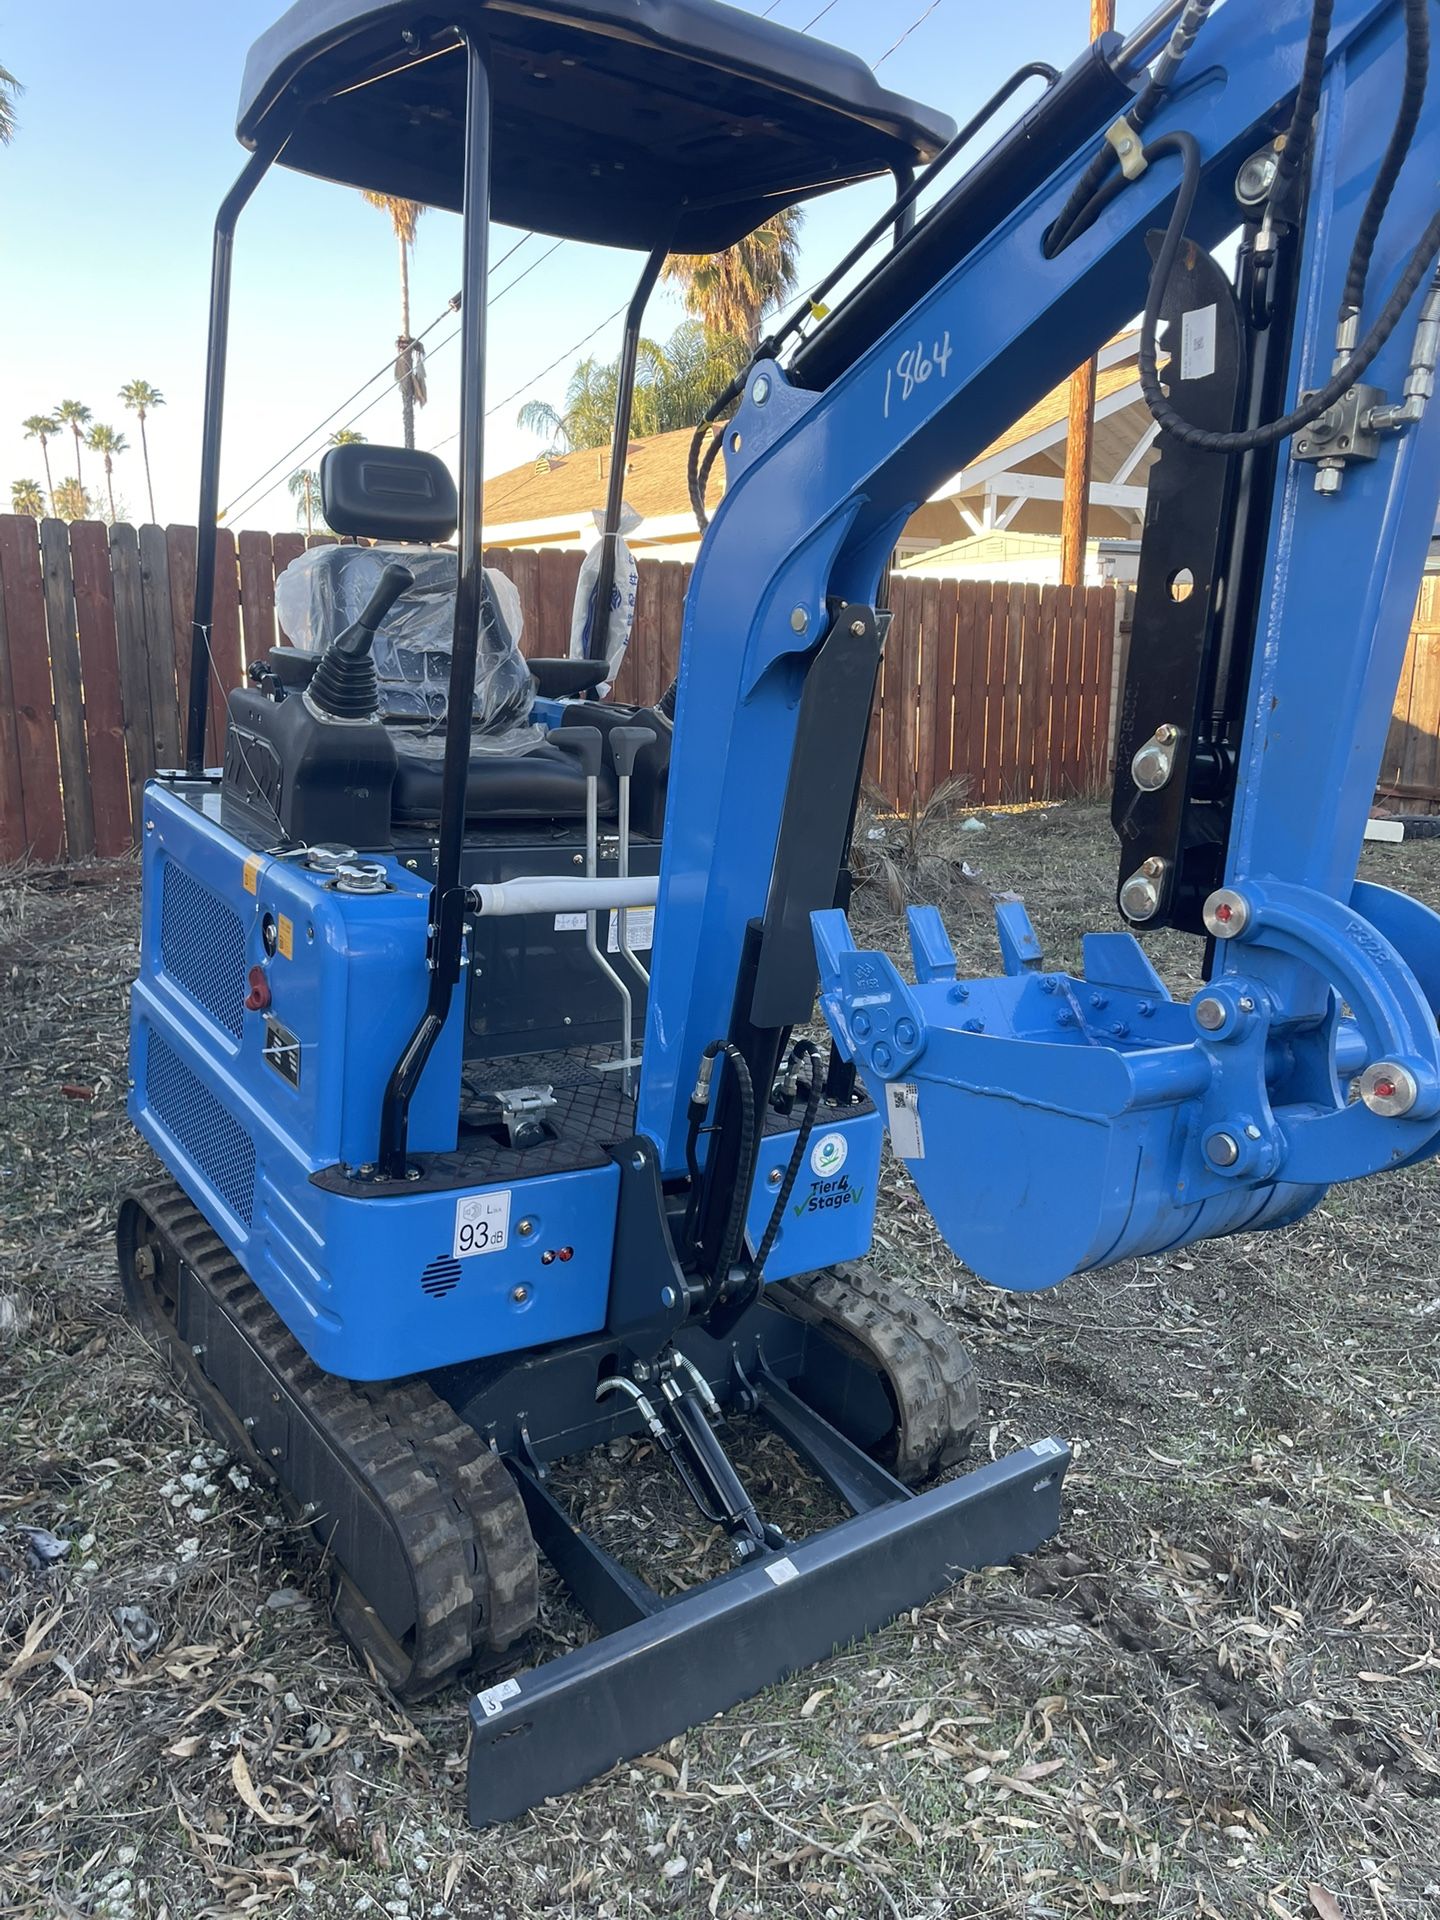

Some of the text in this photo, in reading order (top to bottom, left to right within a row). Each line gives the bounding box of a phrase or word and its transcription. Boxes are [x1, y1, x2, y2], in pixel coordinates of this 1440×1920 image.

[884, 330, 952, 418] 1864
[807, 1193, 851, 1212] Stage
[459, 1221, 503, 1251] 93 dB
